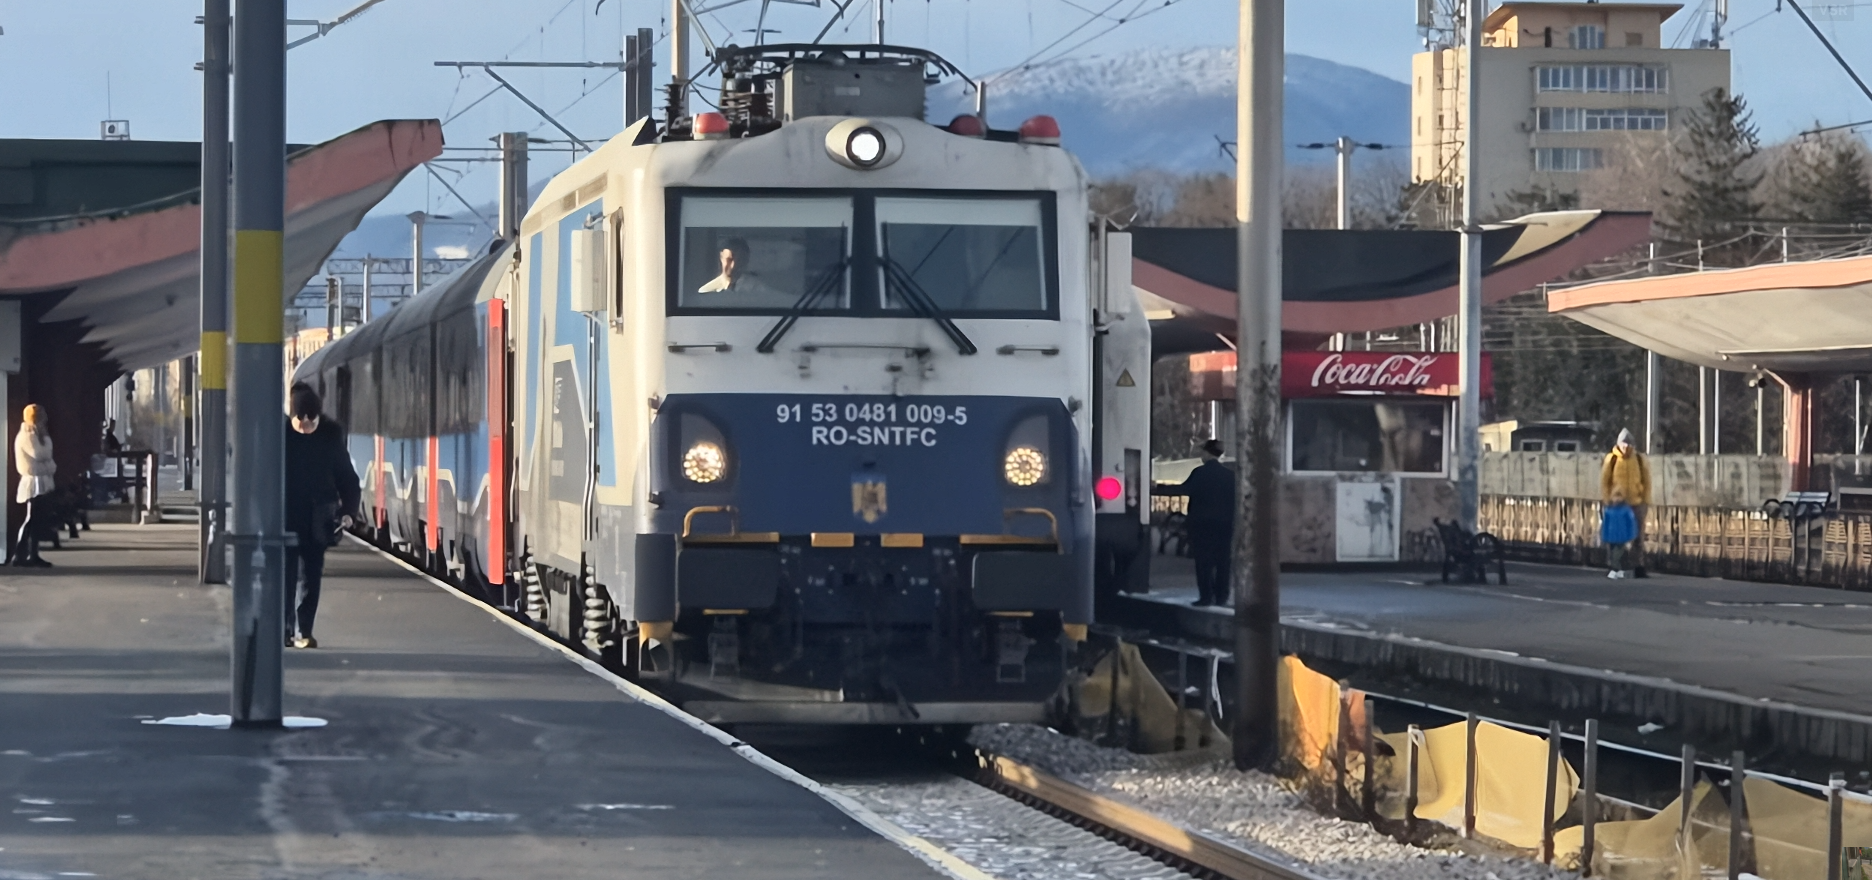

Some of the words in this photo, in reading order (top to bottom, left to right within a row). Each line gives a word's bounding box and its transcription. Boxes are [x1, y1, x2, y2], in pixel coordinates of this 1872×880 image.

[776, 404, 801, 423] 91
[811, 403, 837, 422] 53
[845, 403, 897, 422] 0481
[906, 404, 967, 425] 009-5
[812, 426, 937, 446] RO-SNTFC
